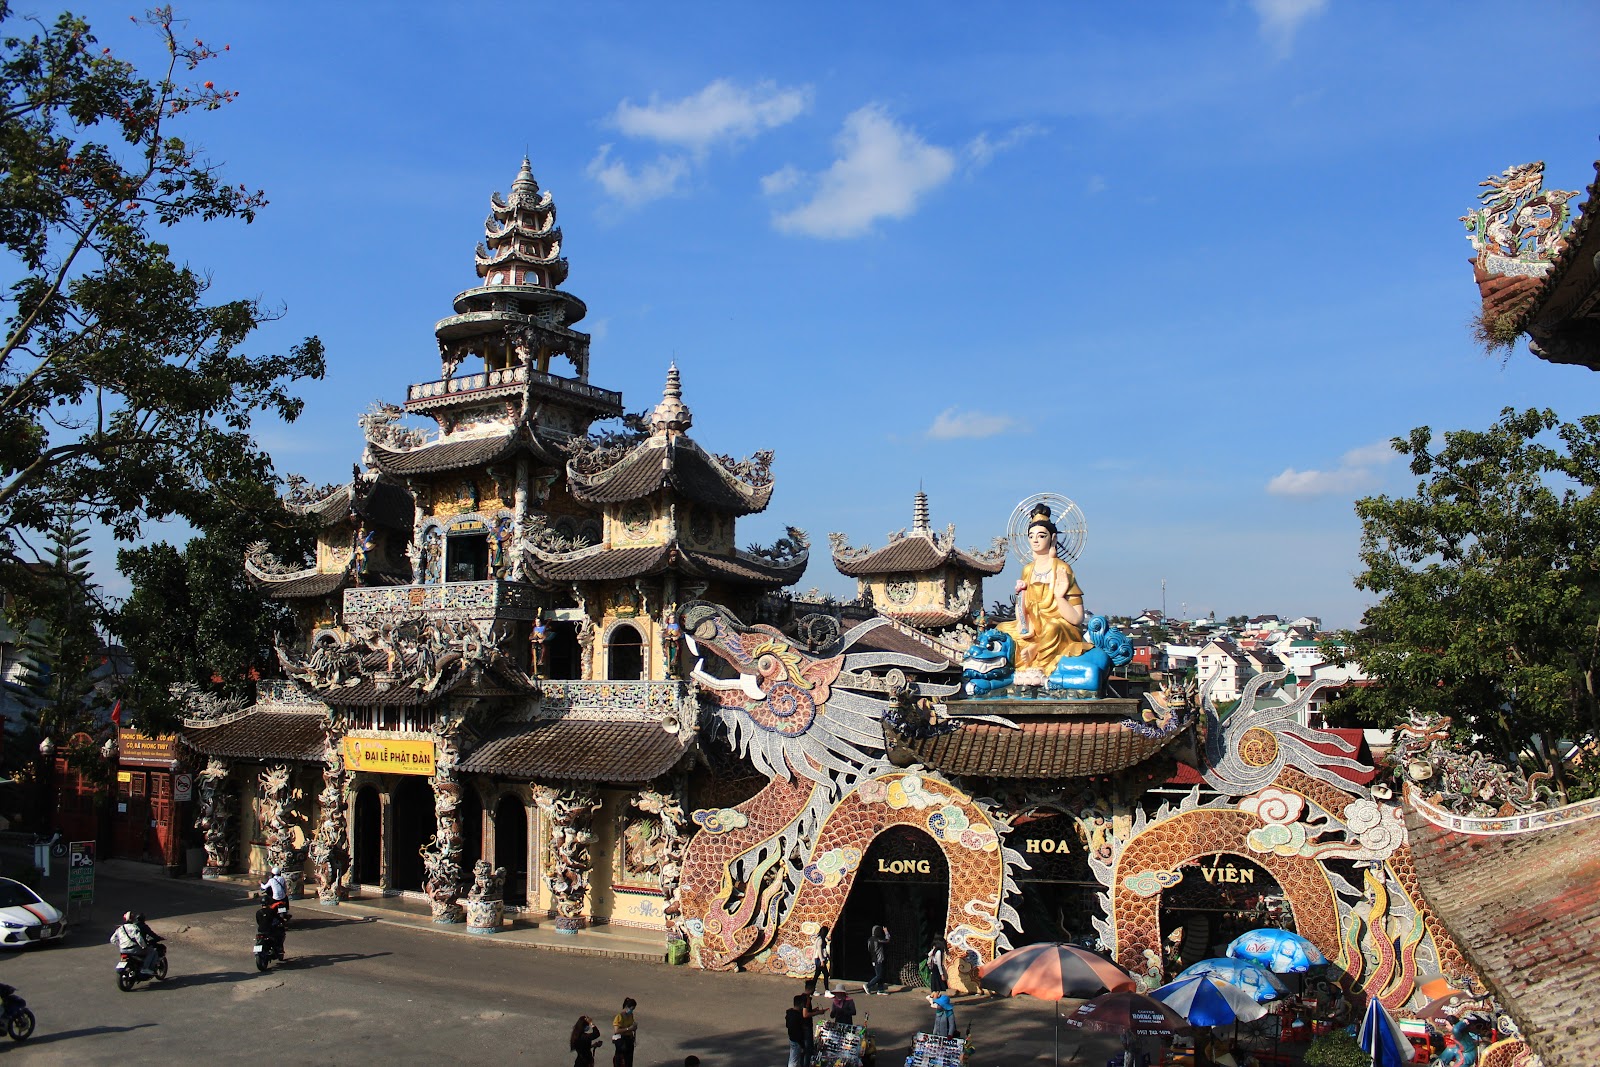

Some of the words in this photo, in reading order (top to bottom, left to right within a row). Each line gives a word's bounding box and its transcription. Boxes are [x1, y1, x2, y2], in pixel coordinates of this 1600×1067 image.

[365, 751, 378, 764] ĐẠI
[380, 747, 388, 762] LỄ
[390, 750, 410, 766] PHẬT
[1026, 839, 1070, 853] HOA
[71, 852, 83, 867] P
[878, 859, 930, 874] LONG
[1201, 863, 1254, 883] VIÊN
